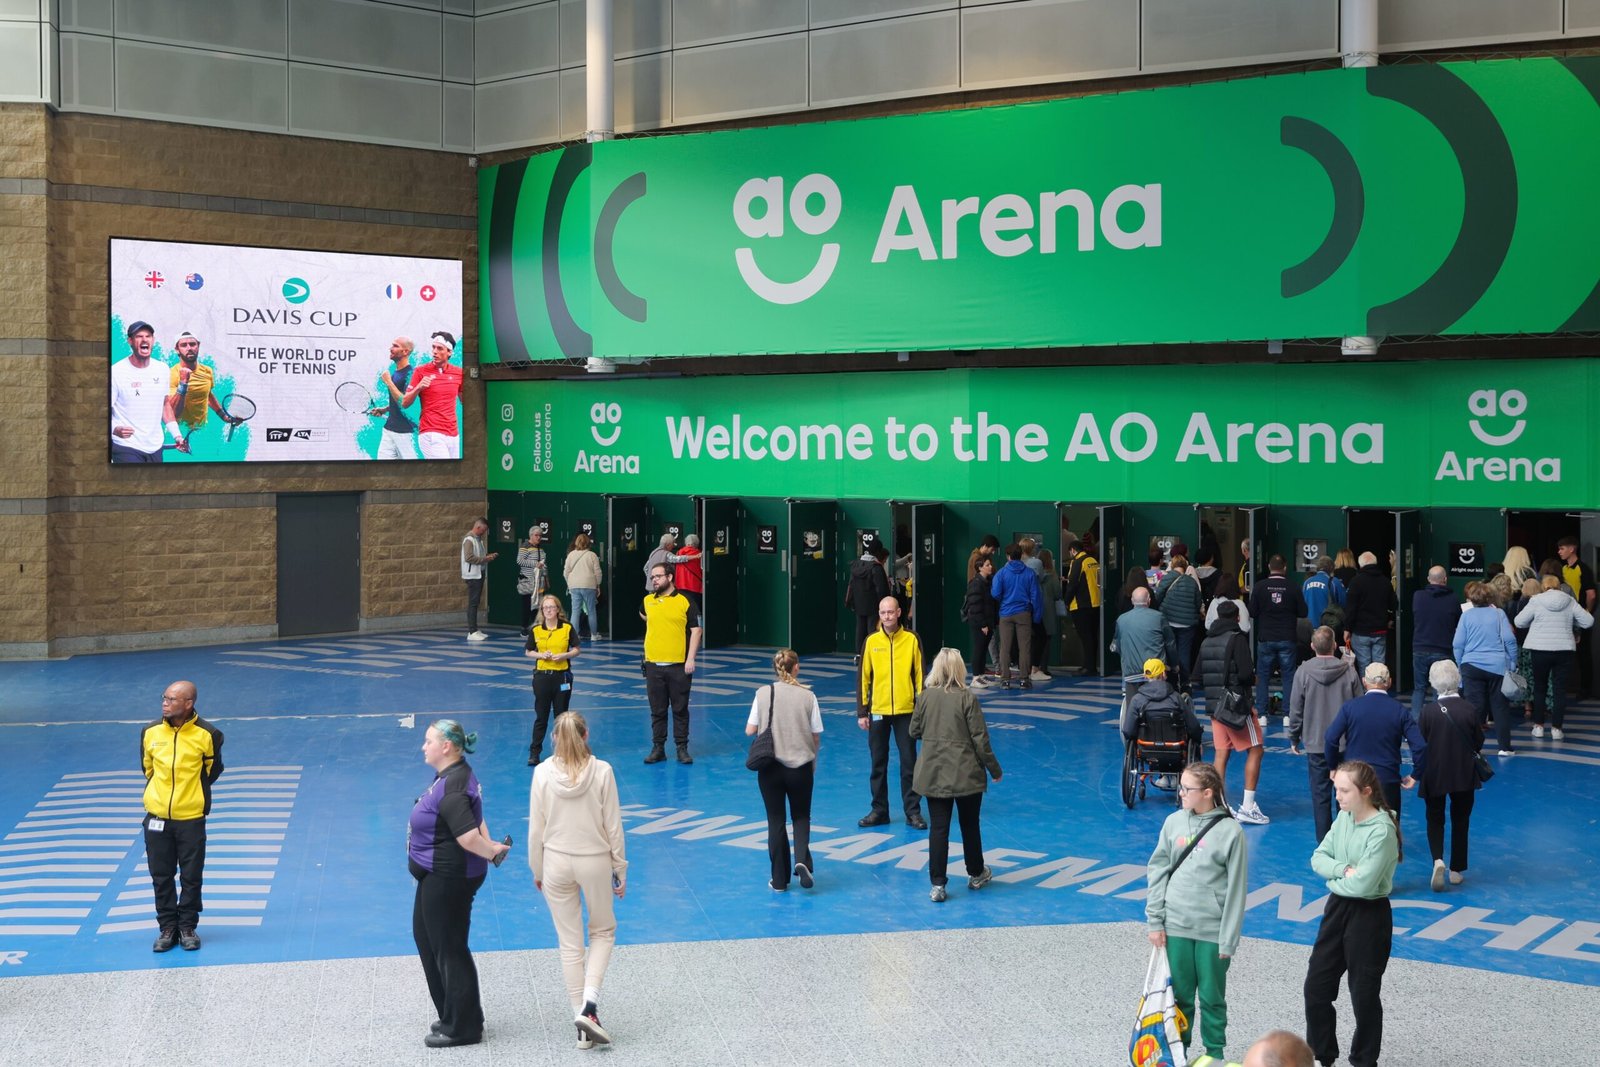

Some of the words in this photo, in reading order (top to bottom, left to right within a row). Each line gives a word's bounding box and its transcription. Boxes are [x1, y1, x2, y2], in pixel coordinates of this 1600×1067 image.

[733, 173, 842, 239] ao
[871, 183, 1162, 263] Arena
[233, 308, 302, 325] DAVIS
[310, 311, 358, 327] CUP
[237, 347, 267, 359] THE
[271, 348, 324, 360] WORLD
[328, 349, 357, 361] CUP
[259, 362, 278, 374] OF
[282, 362, 336, 375] TENNIS
[590, 402, 622, 424] ao
[1468, 389, 1528, 417] ao
[534, 412, 542, 428] us
[269, 430, 284, 440] ITF
[543, 403, 554, 473] @aoarena
[665, 413, 874, 462] Welcome
[884, 416, 939, 462] to
[950, 411, 1049, 462] the
[1064, 411, 1158, 463] AO
[1175, 411, 1384, 464] Arena
[533, 430, 542, 472] Follow
[574, 450, 640, 474] Arena
[1434, 450, 1561, 482] Arena
